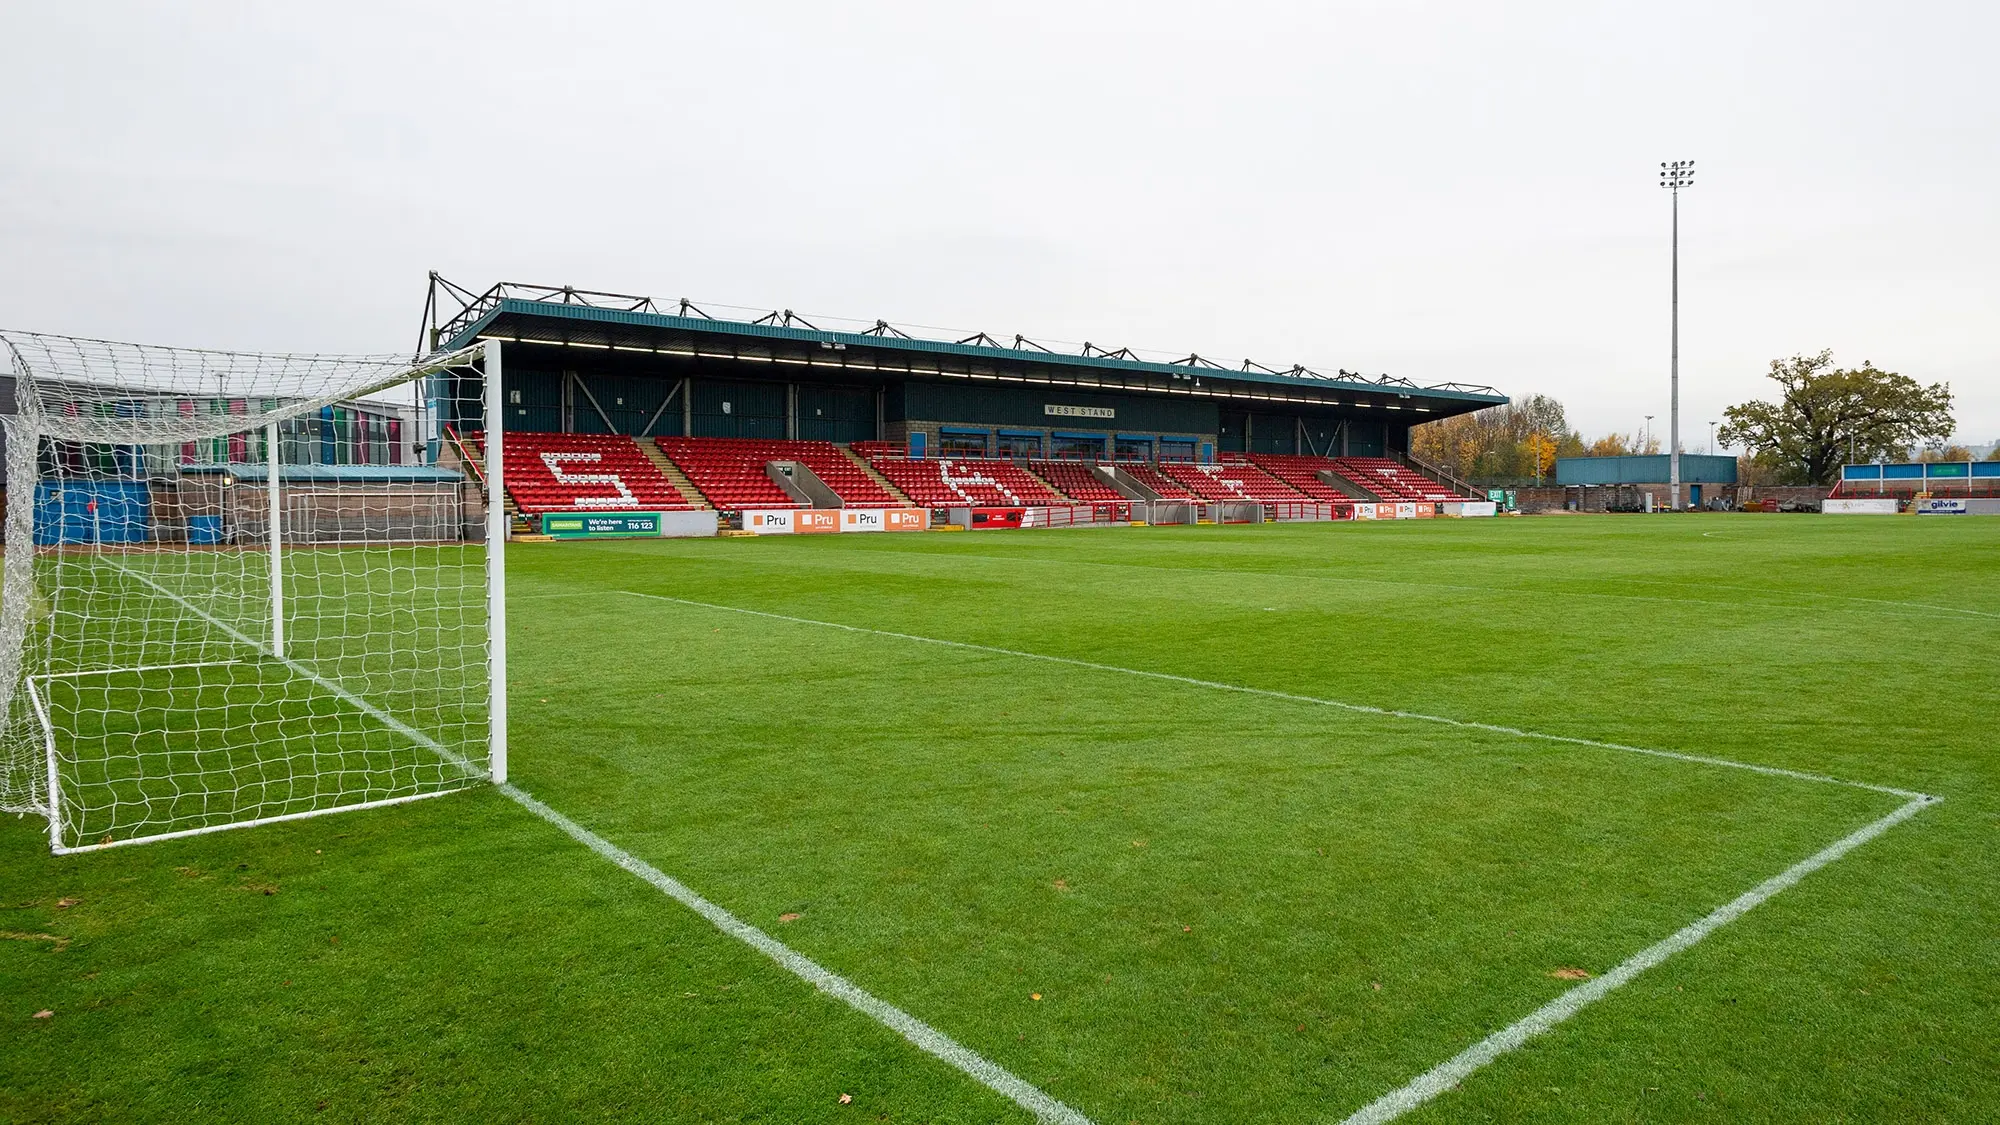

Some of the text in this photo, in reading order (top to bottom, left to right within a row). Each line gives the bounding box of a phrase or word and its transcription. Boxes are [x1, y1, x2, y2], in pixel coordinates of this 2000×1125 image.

[1048, 406, 1112, 416] WEST STAND
[1931, 500, 1958, 509] gilvie
[766, 514, 786, 525] Pru
[814, 514, 833, 525] Pru
[860, 514, 877, 524] Pru
[902, 513, 919, 523] Pru
[628, 522, 640, 530] 116
